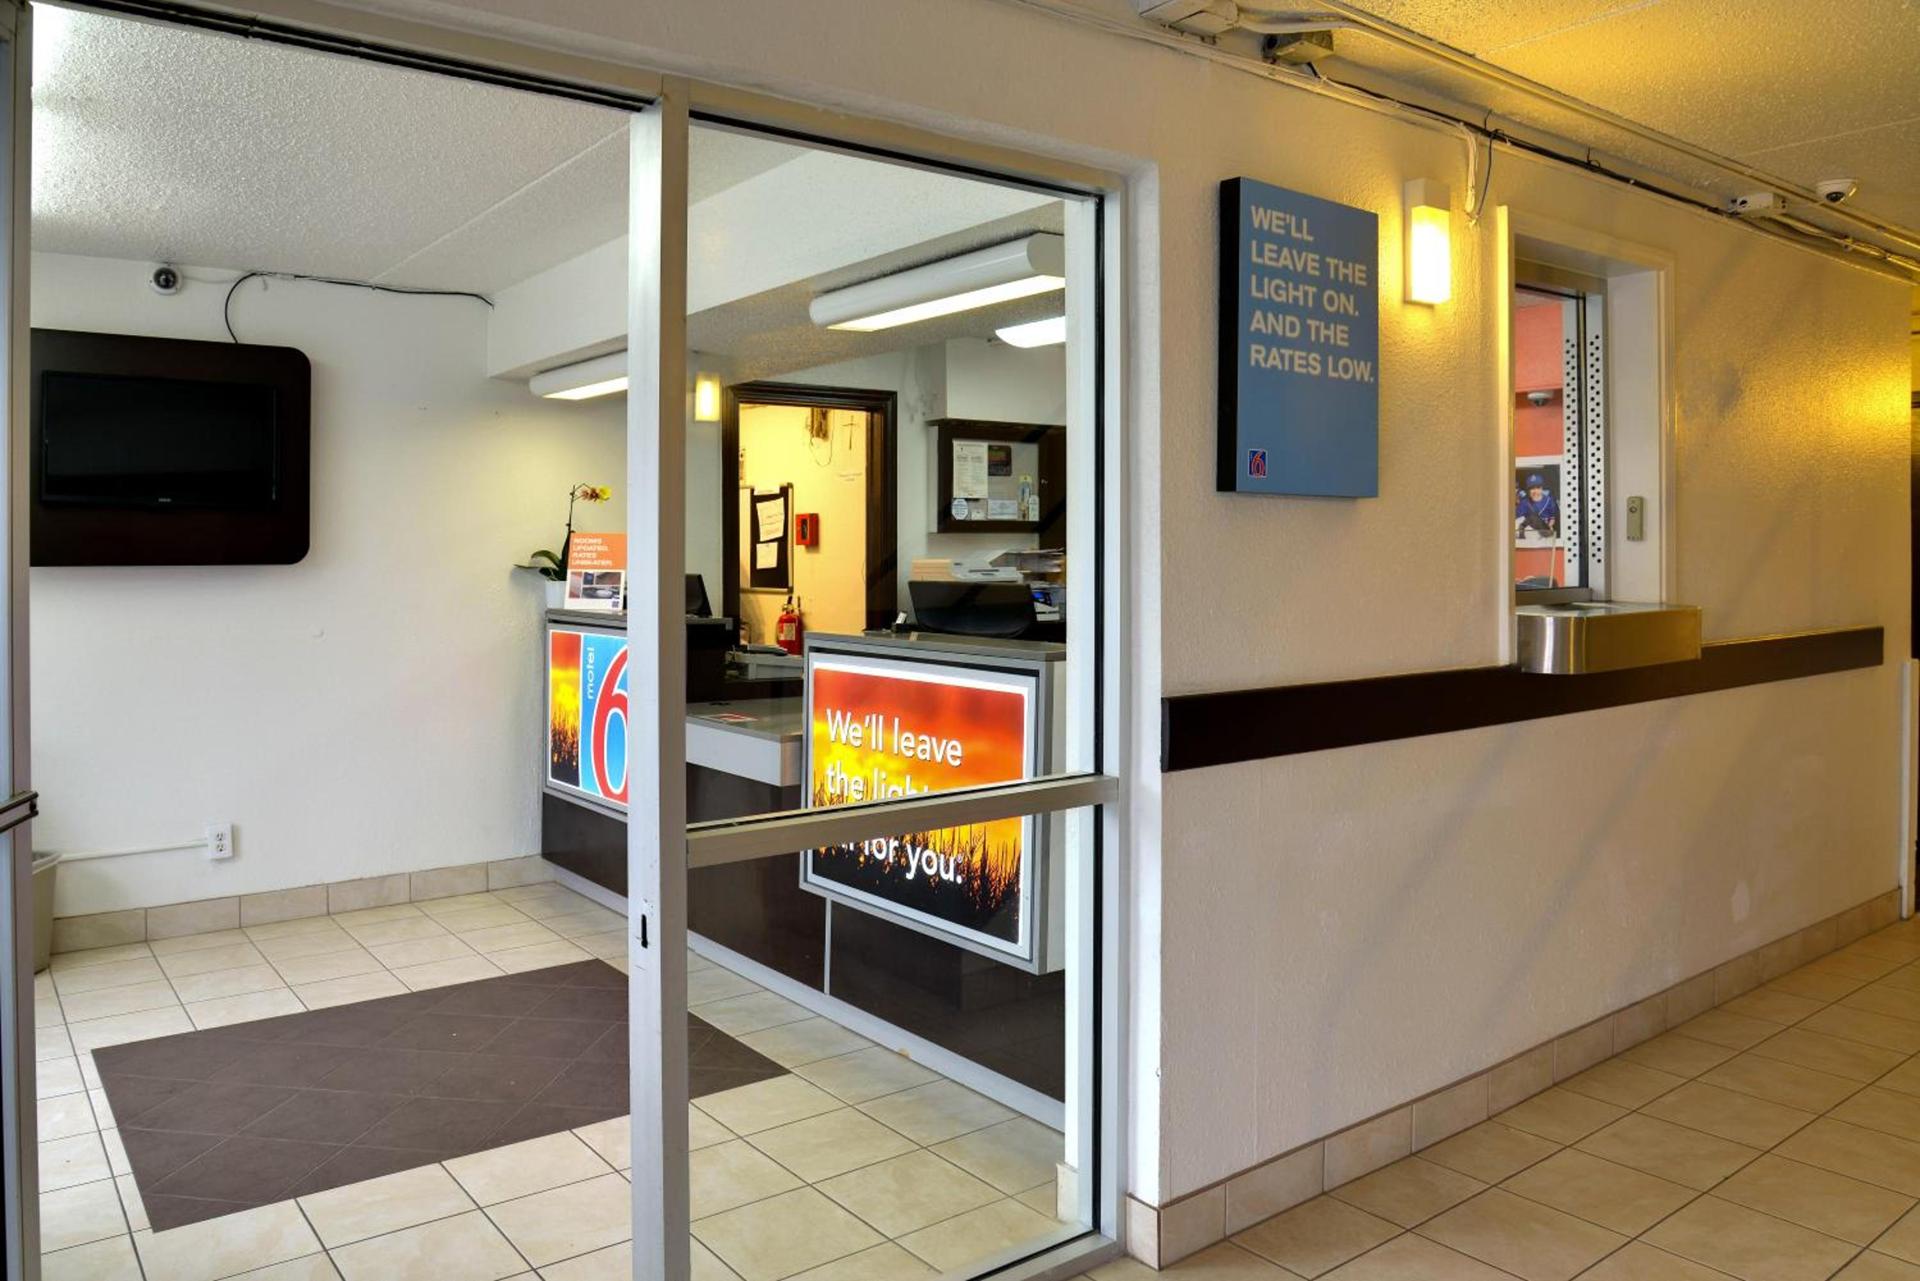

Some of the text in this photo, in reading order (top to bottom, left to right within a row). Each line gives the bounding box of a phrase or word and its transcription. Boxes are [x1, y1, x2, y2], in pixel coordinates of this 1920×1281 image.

[1251, 205, 1314, 241] WE'LL
[1251, 240, 1367, 286] LEAVE THE
[1251, 274, 1359, 316] LIGHT ON.
[1250, 310, 1349, 347] AND THE
[1250, 344, 1375, 383] RATES LOW.
[1251, 449, 1265, 478] 6
[587, 647, 595, 700] motel
[591, 645, 628, 805] 6
[826, 708, 963, 767] We'll leave
[826, 760, 864, 801] the
